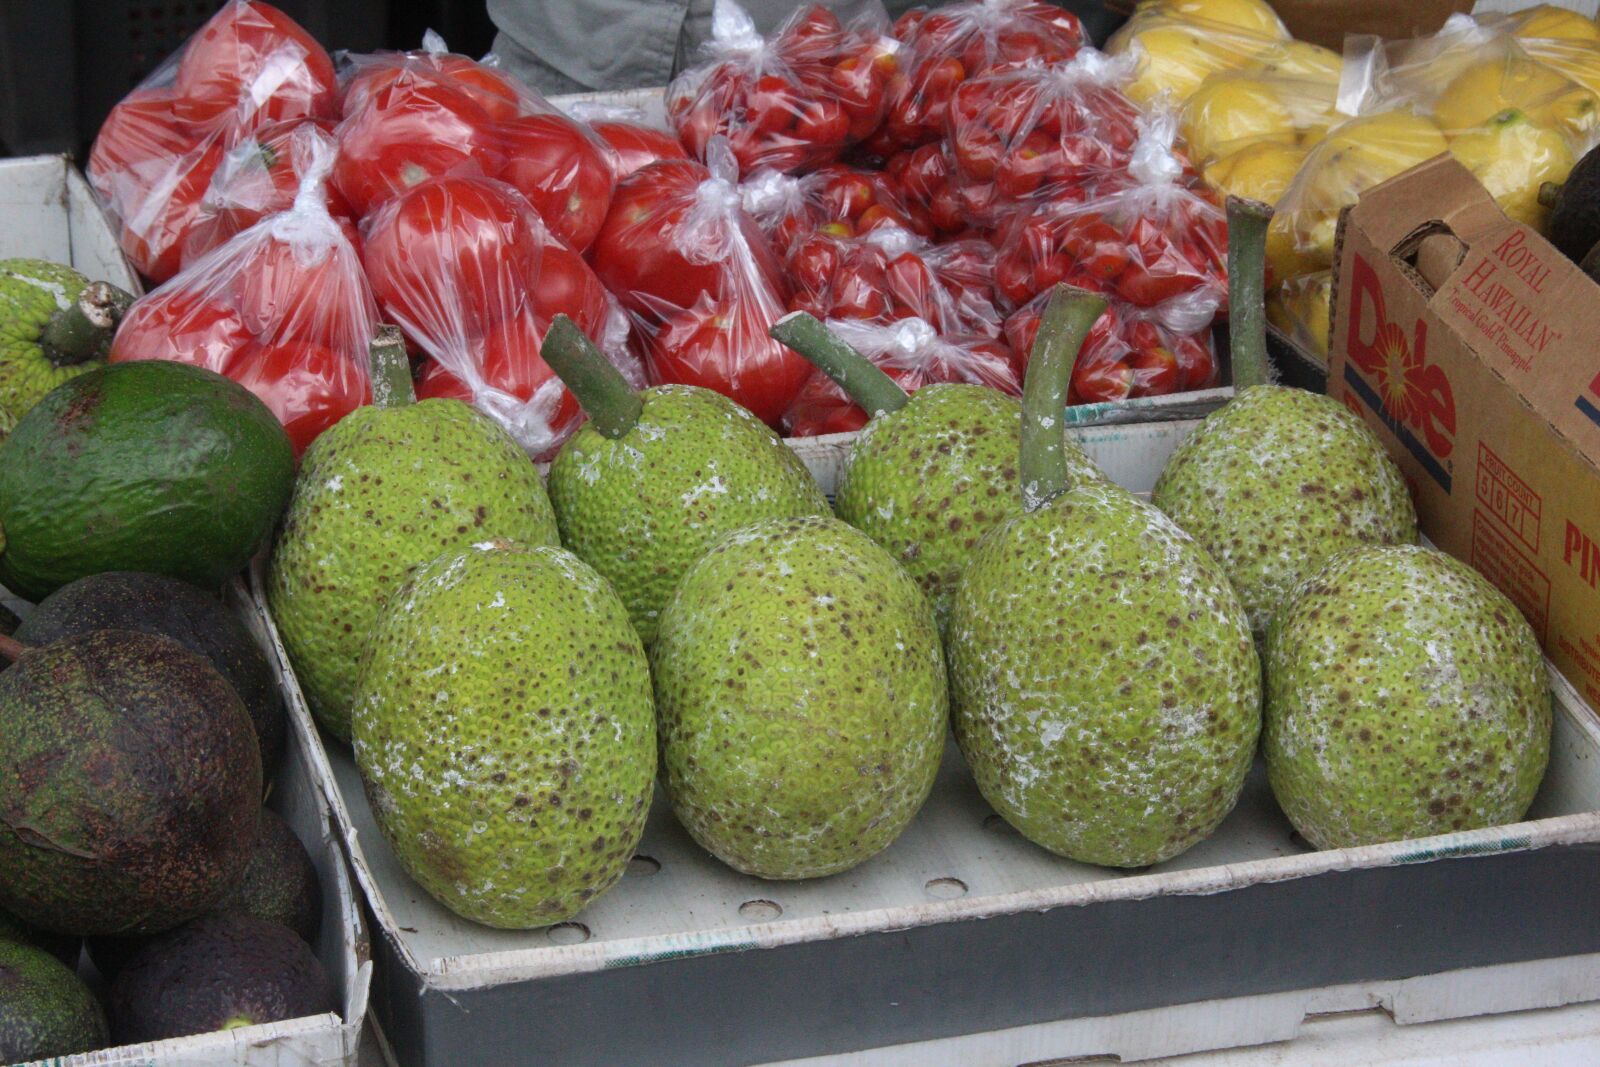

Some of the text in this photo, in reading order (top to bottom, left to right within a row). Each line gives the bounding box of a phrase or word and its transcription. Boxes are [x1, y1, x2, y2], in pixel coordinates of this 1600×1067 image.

[1492, 229, 1551, 293] ROYAL
[1347, 252, 1456, 459] Dole
[1450, 287, 1482, 322] Tropical
[1495, 333, 1533, 373] Pineapple
[1481, 476, 1488, 496] 5
[1511, 503, 1519, 524] 7
[1485, 453, 1533, 507] FRUIT COUNT
